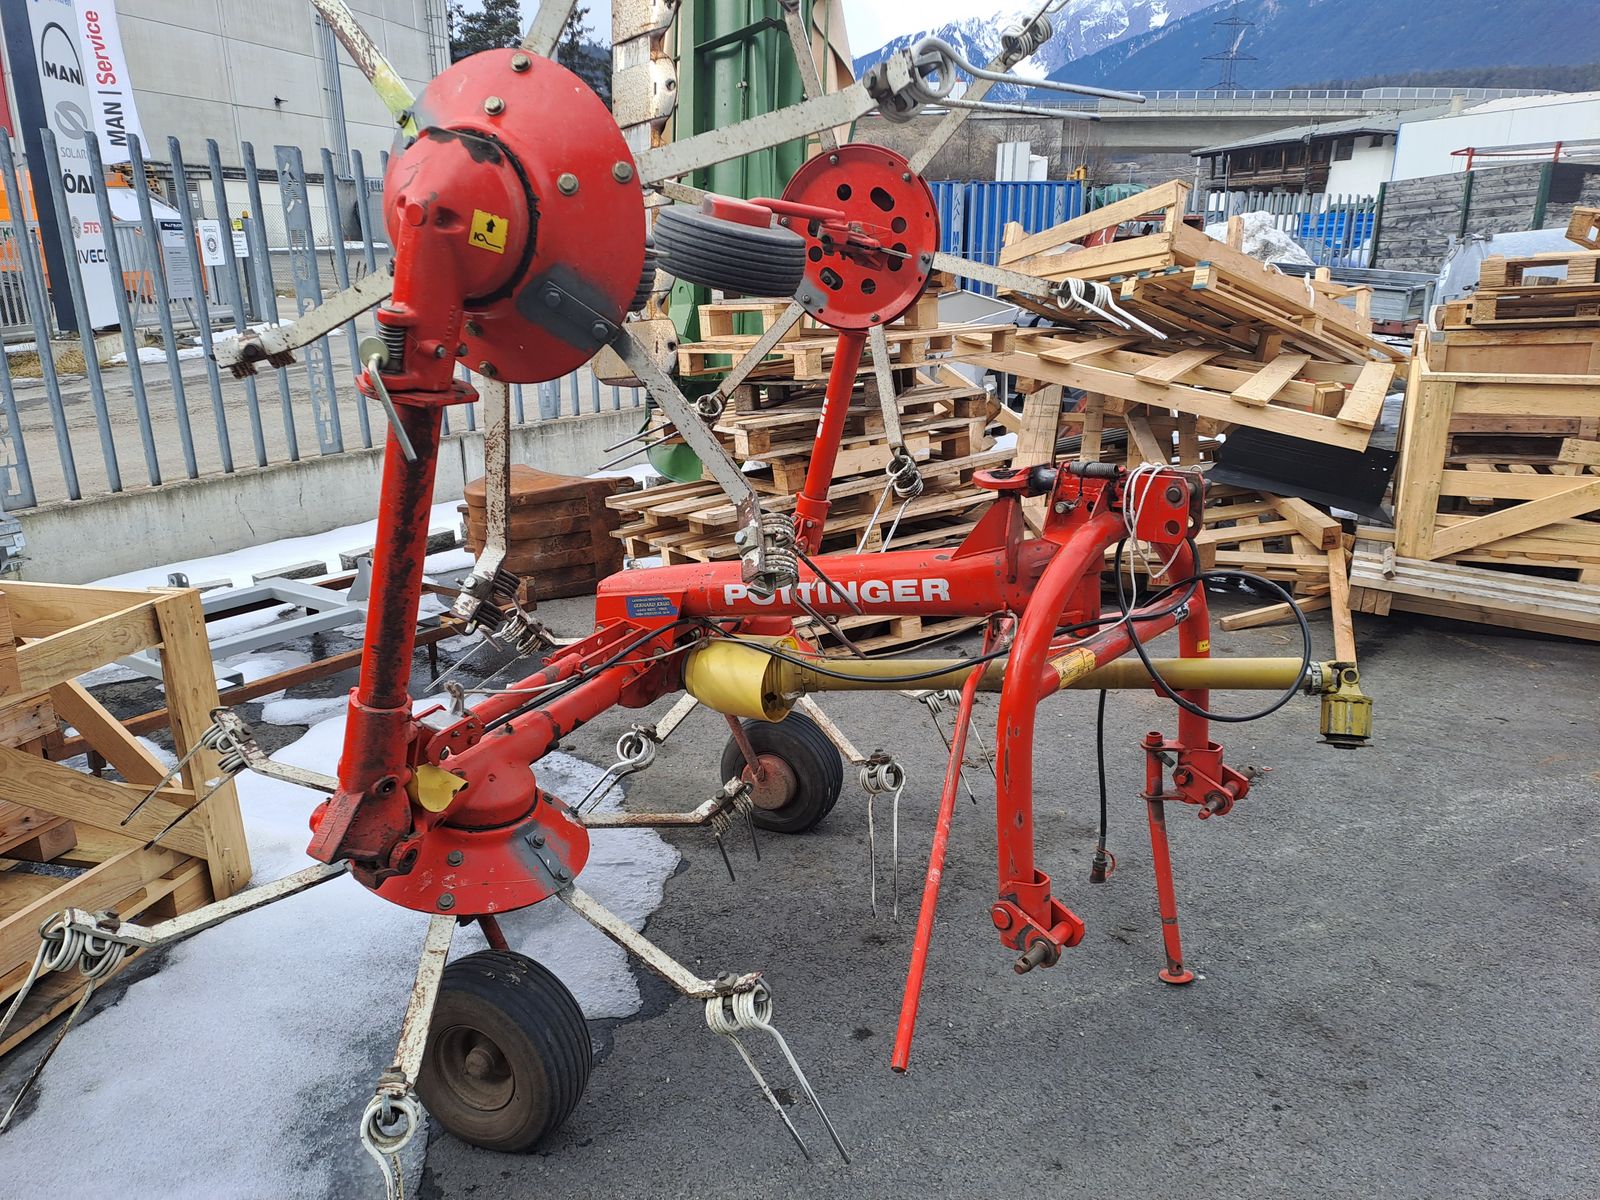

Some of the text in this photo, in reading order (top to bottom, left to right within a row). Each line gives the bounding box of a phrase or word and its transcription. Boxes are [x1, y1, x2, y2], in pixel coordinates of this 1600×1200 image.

[45, 61, 81, 86] MAN
[85, 10, 127, 147] MAN Service
